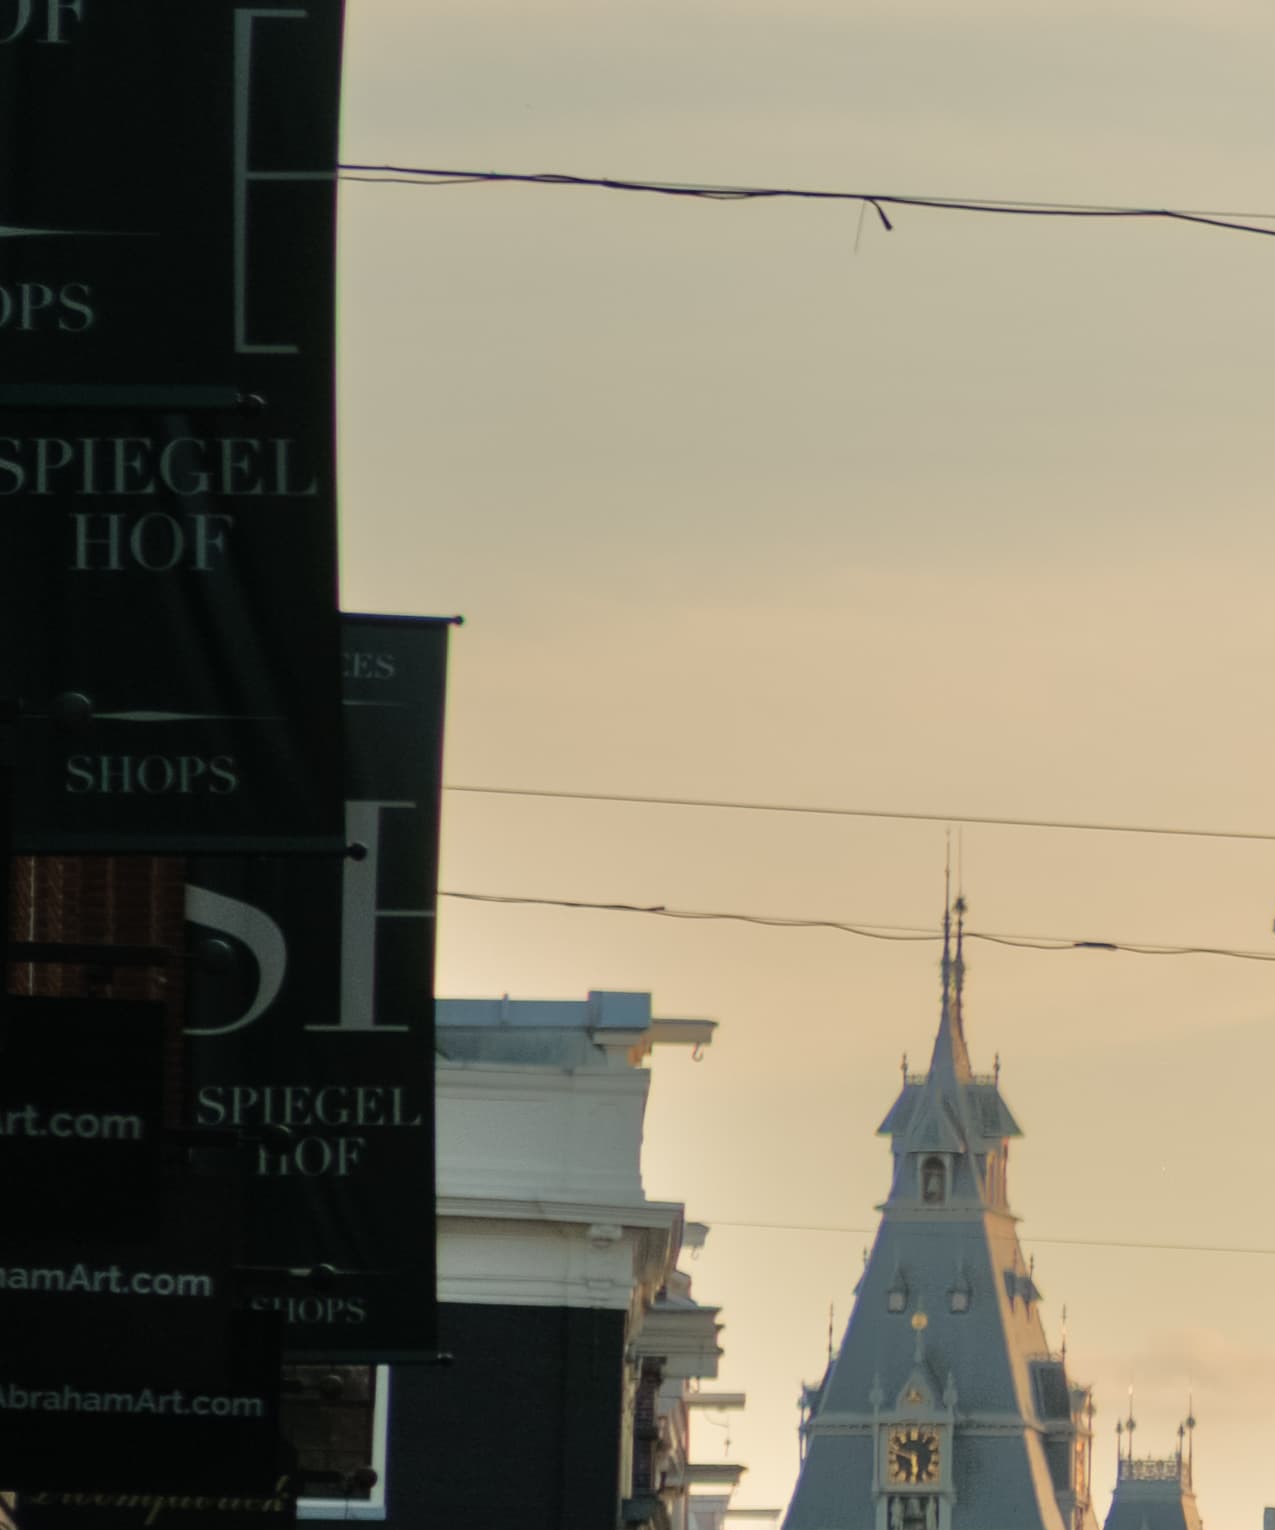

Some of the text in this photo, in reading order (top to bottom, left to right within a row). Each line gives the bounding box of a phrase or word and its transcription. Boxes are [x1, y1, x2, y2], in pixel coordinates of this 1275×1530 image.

[0, 436, 319, 497] SPIEGEL
[66, 511, 237, 572] HOF
[341, 652, 397, 679] ES
[65, 754, 241, 794] SHOPS
[0, 1104, 143, 1140] rt.com
[196, 1085, 424, 1127] SPIEGEL
[256, 1135, 366, 1177] HOF
